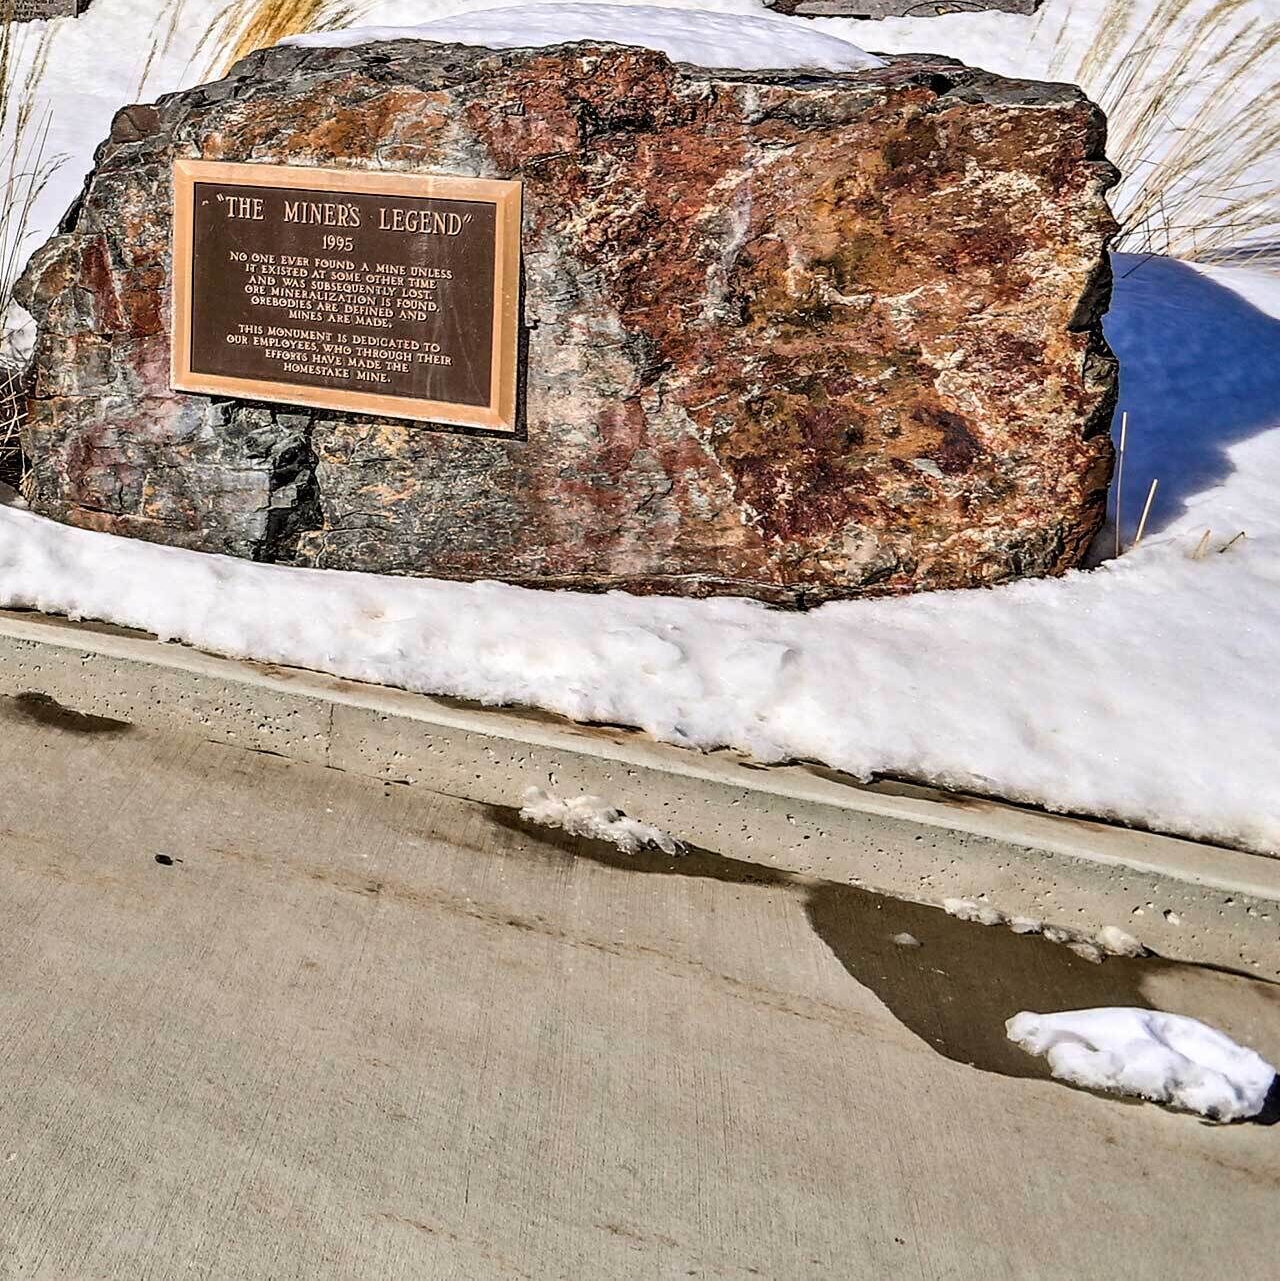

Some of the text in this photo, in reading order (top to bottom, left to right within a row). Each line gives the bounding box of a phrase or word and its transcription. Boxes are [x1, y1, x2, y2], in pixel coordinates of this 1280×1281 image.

[216, 193, 472, 235] "THE MINER'S LEGEND"
[322, 235, 353, 251] 1995
[230, 251, 452, 279] NO ONE EVER FOUND A MINE UNLESS
[245, 264, 437, 289] IT EXISTED AT SOME OTHER TIME
[245, 285, 440, 312] ORE MINERALIZATION IS FOUND,
[249, 275, 432, 300] AND WAS SUBSEQUENTLY LOST.
[251, 296, 427, 320] OREBODIES ARE DEFINED AND
[289, 310, 322, 321] MINES
[328, 314, 350, 324] ARE
[227, 334, 452, 365] OUR EMPLOYEES, WHO THROUGH THEIR
[238, 324, 440, 352] THIS MONUMENT IS DEDICATED TO
[265, 349, 409, 373] EFFORTS HAVE MADE THE
[284, 362, 391, 383] HOMESTAKE MINE.
